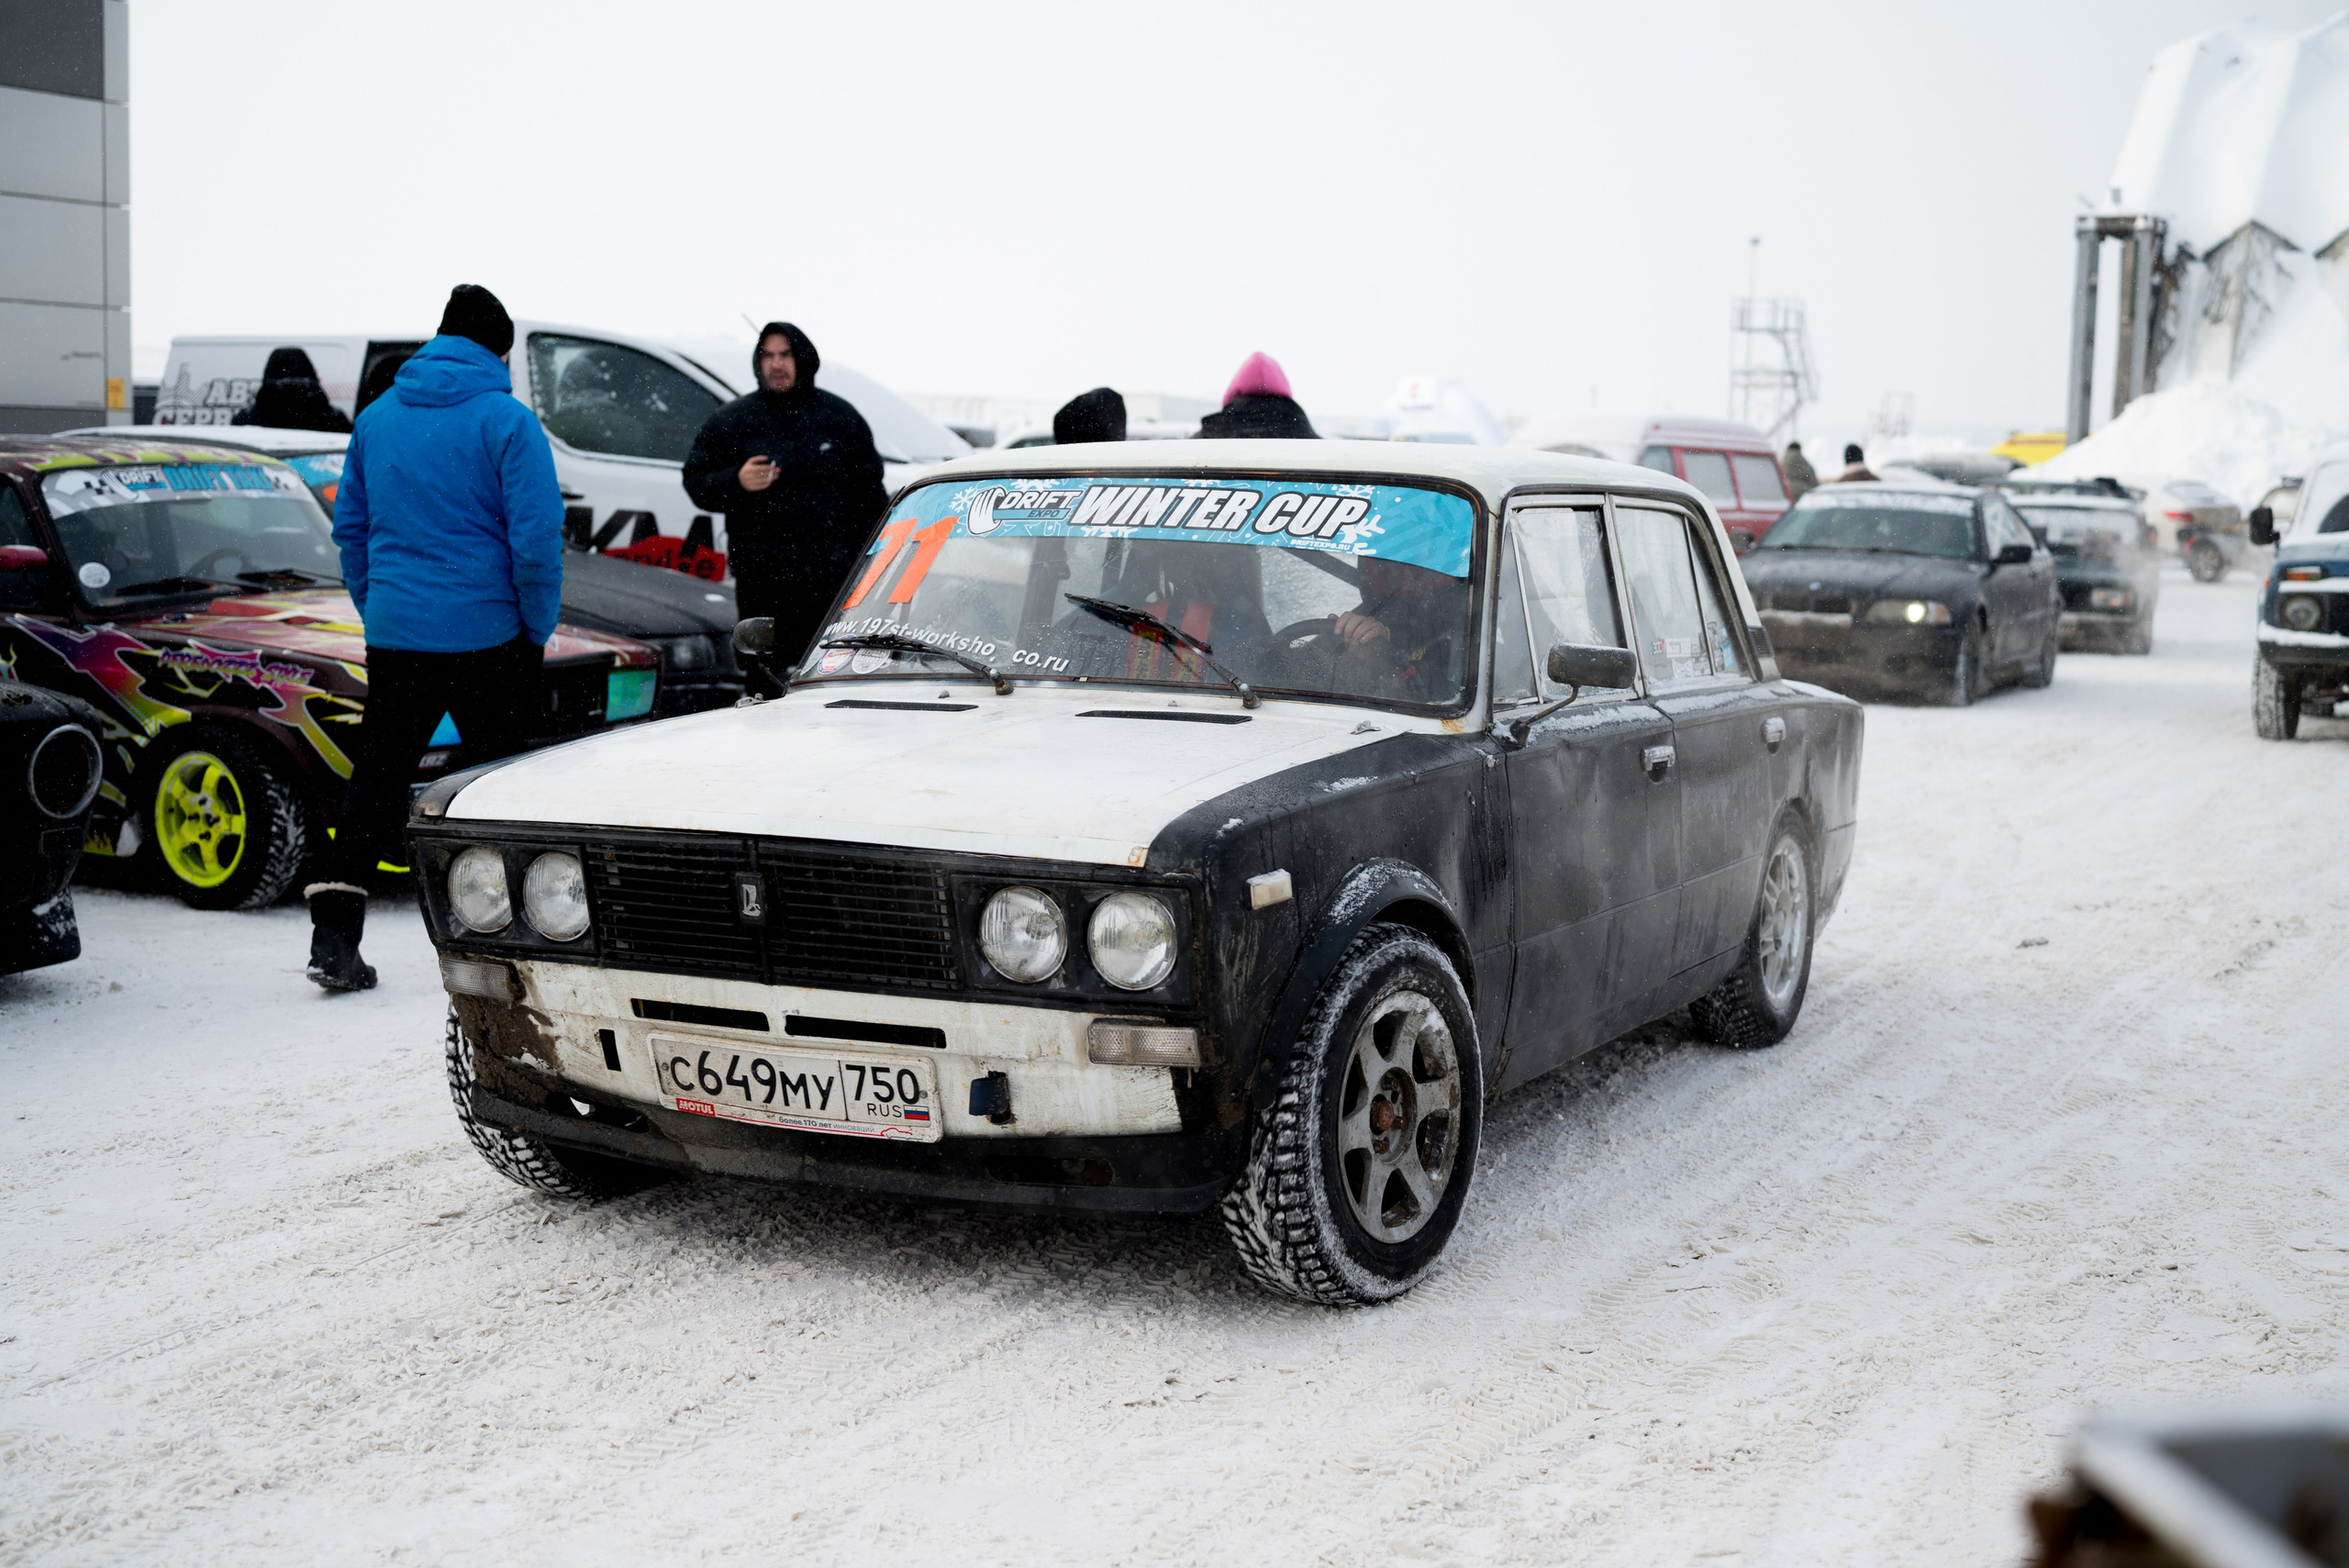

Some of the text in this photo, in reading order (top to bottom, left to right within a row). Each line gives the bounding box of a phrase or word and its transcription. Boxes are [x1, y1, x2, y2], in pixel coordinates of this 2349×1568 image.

[121, 468, 161, 484] DRIFT
[161, 464, 228, 493] DRIFT
[1000, 490, 1083, 510] DRIFT
[1027, 508, 1060, 518] EXPO
[1068, 484, 1372, 539] WINTER CUP
[1290, 539, 1352, 550] DRIFTEXPO.RU
[845, 1063, 920, 1105] 750
[678, 1099, 714, 1115] MOTUL
[866, 1102, 902, 1118] RUS
[778, 1116, 875, 1134] более 170 лет инноваций
